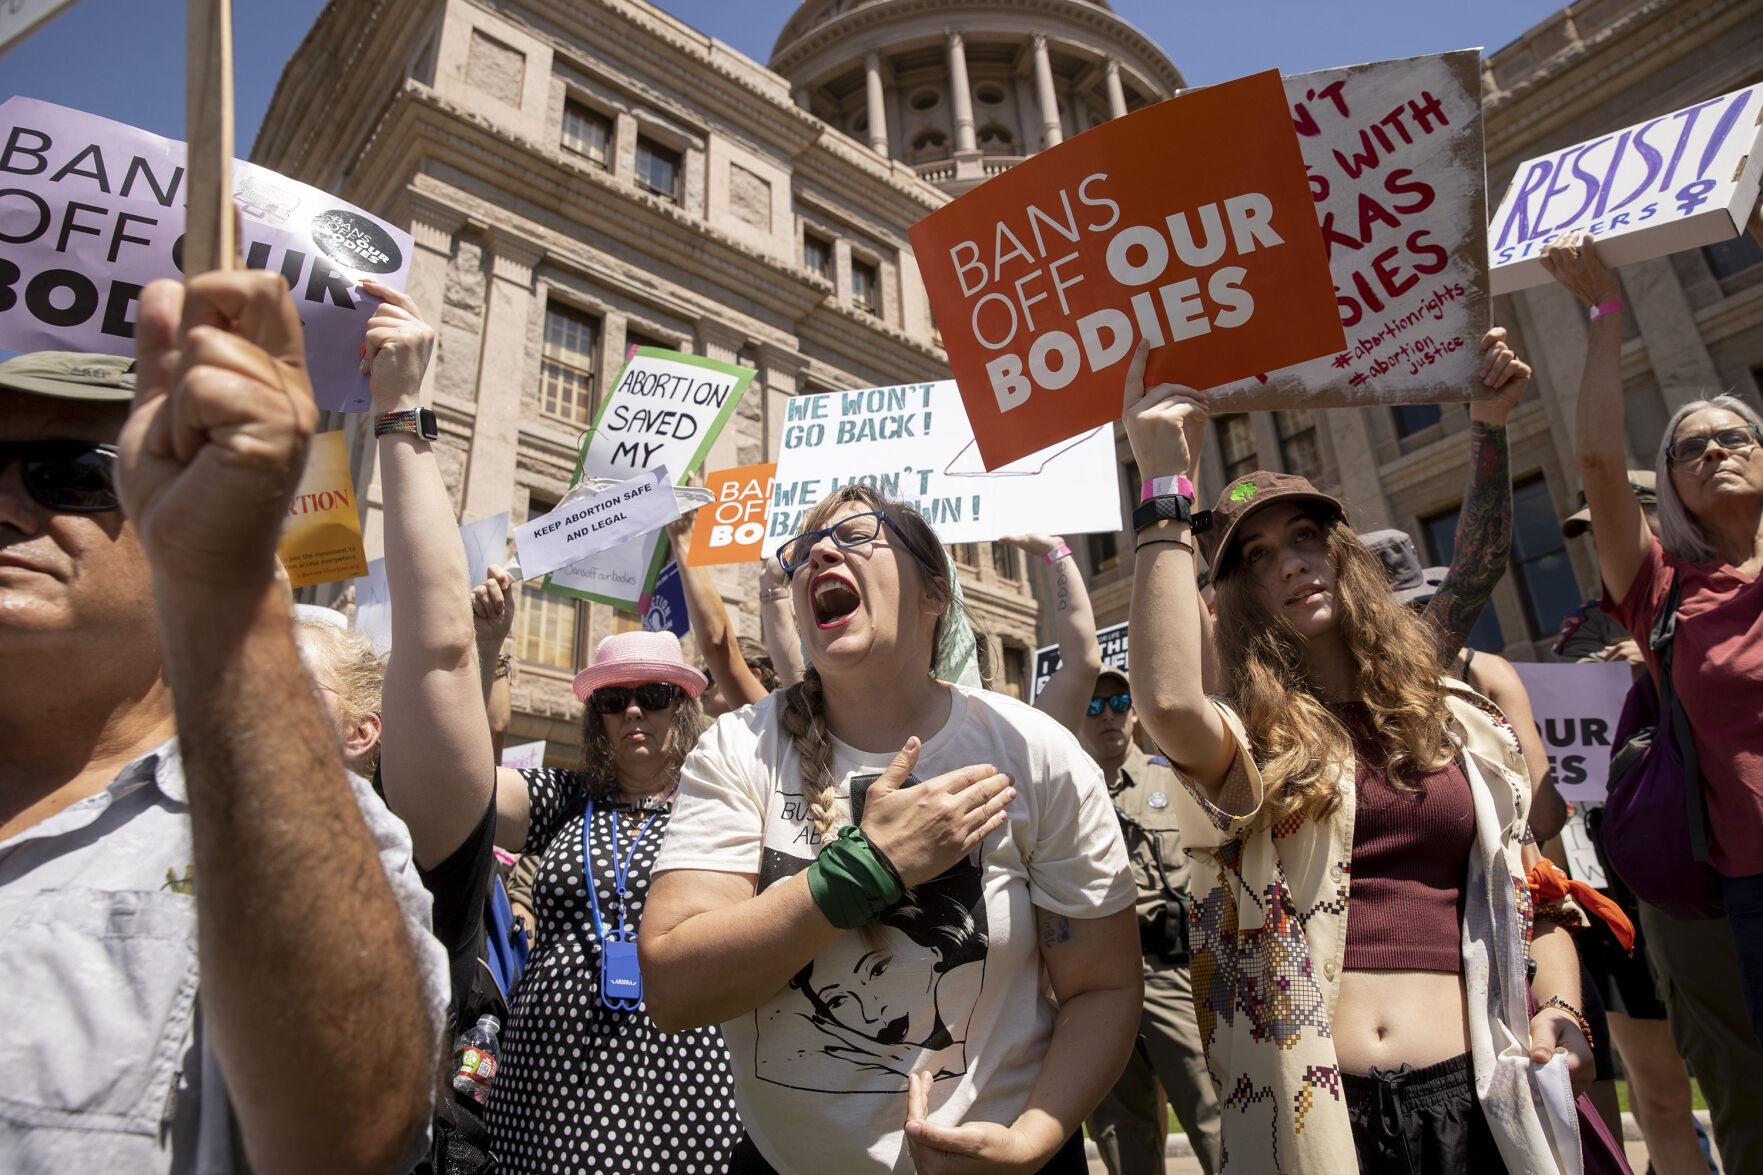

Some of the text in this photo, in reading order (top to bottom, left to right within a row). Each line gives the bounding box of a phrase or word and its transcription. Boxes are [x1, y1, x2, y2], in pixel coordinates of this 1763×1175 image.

[1293, 80, 1350, 136] N'T
[1332, 90, 1450, 179] WITH
[0, 126, 188, 209] BAN
[1494, 89, 1753, 251] RESIST!
[331, 215, 373, 243] BANS
[950, 172, 1121, 298] BANS
[1320, 168, 1436, 263] XAS
[1496, 202, 1659, 265] SISERS
[0, 188, 159, 263] OFF
[172, 231, 357, 310] UR
[356, 238, 390, 264] OUR
[971, 192, 1286, 350] OFF OUR
[985, 266, 1254, 415] BODIES
[1331, 282, 1466, 370] #abortionrights
[1349, 334, 1436, 388] #abortion
[1408, 335, 1465, 376] justice
[617, 369, 730, 409] ABORTION
[787, 383, 936, 423] WE WON'T
[607, 405, 698, 441] SAVED
[784, 424, 824, 450] GO
[610, 441, 665, 469] MY
[287, 488, 350, 516] RTION
[720, 476, 776, 502] BA
[774, 478, 822, 508] WE
[533, 483, 652, 539] KEEP ABORTION SAFE
[566, 512, 628, 543] AND LEGAL
[769, 509, 803, 538] BA
[905, 495, 980, 525] WN!
[1534, 717, 1611, 748] UR
